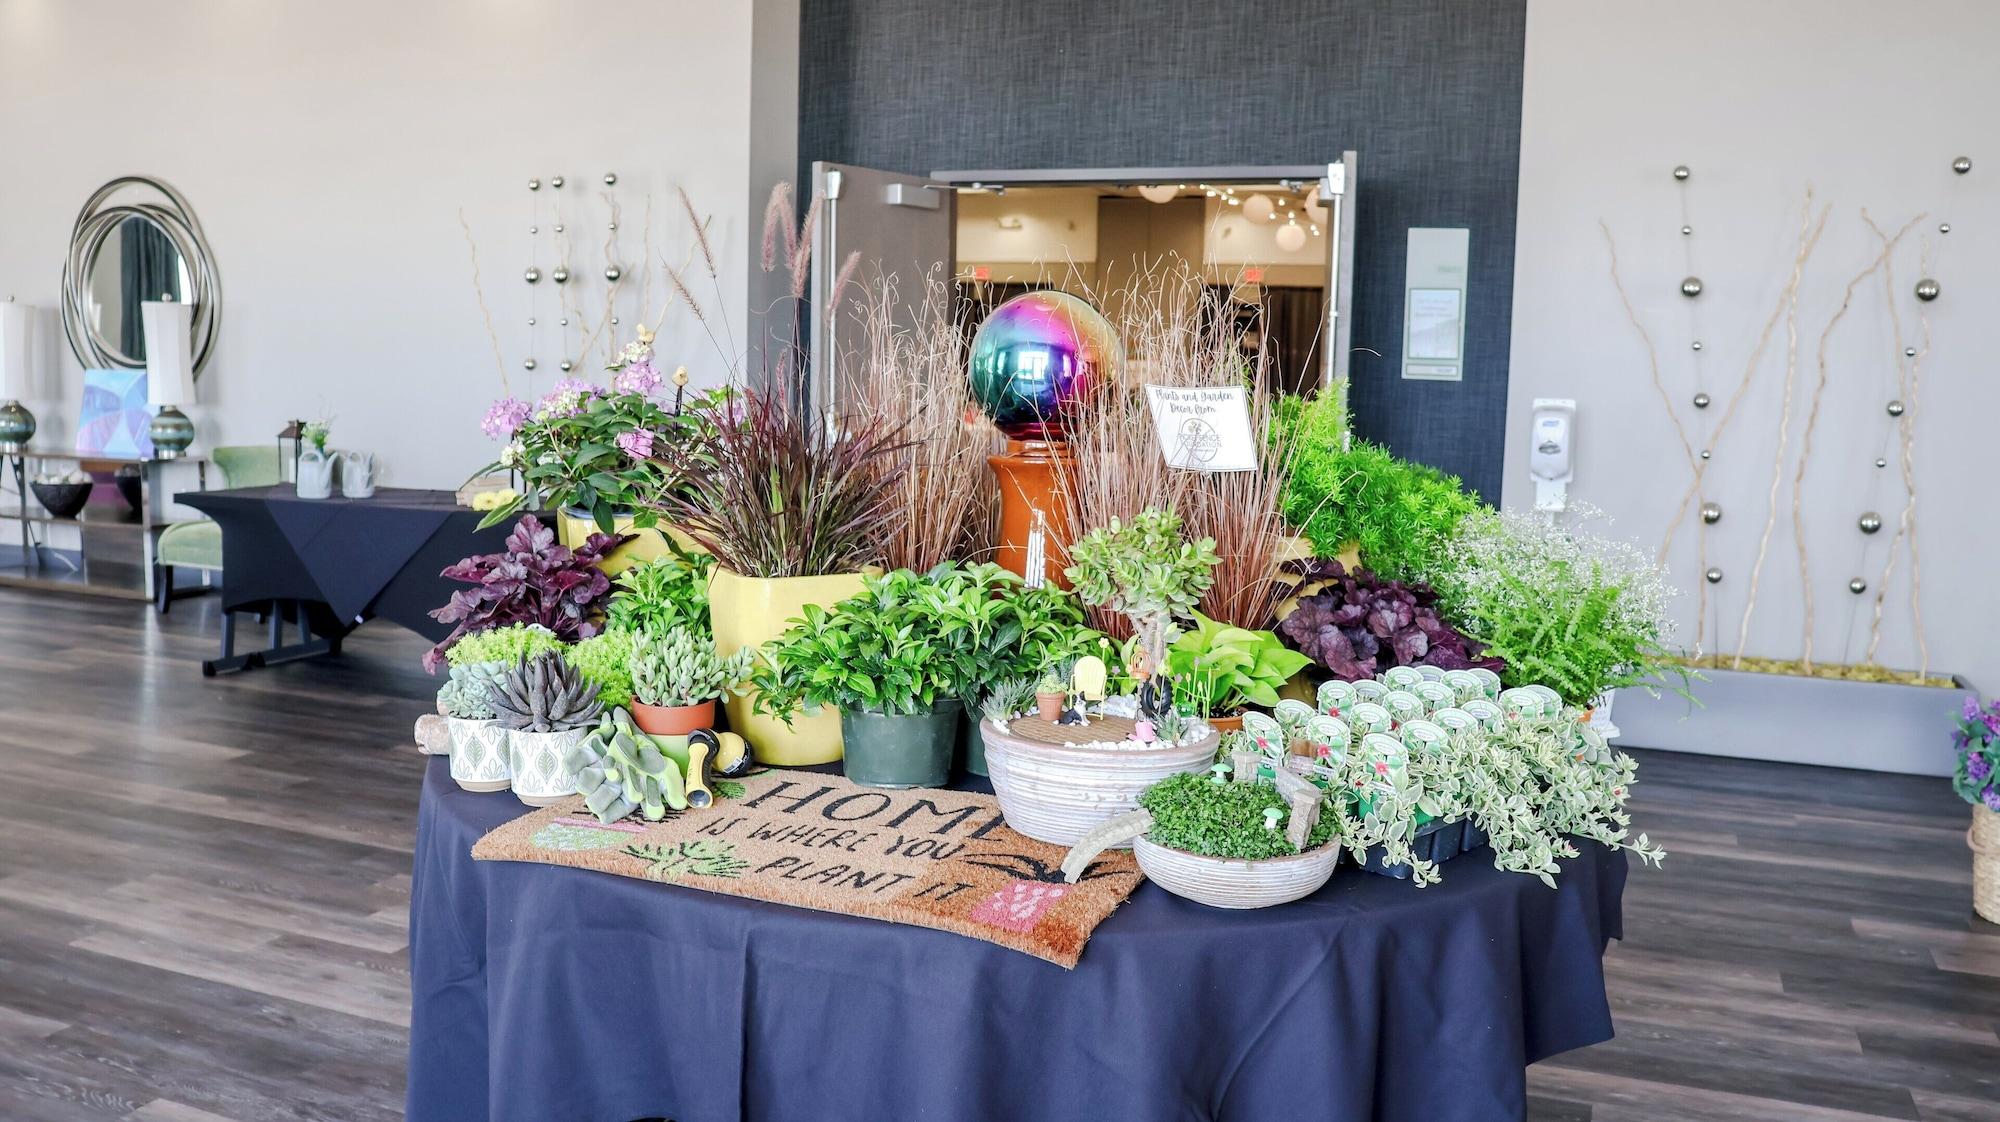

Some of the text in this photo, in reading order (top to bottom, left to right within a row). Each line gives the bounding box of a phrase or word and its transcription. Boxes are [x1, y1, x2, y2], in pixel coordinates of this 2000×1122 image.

[1156, 389, 1179, 400] Plants
[1181, 392, 1198, 402] and
[697, 817, 965, 860] IS WHERE YOU
[755, 856, 977, 901] PLANT IT
